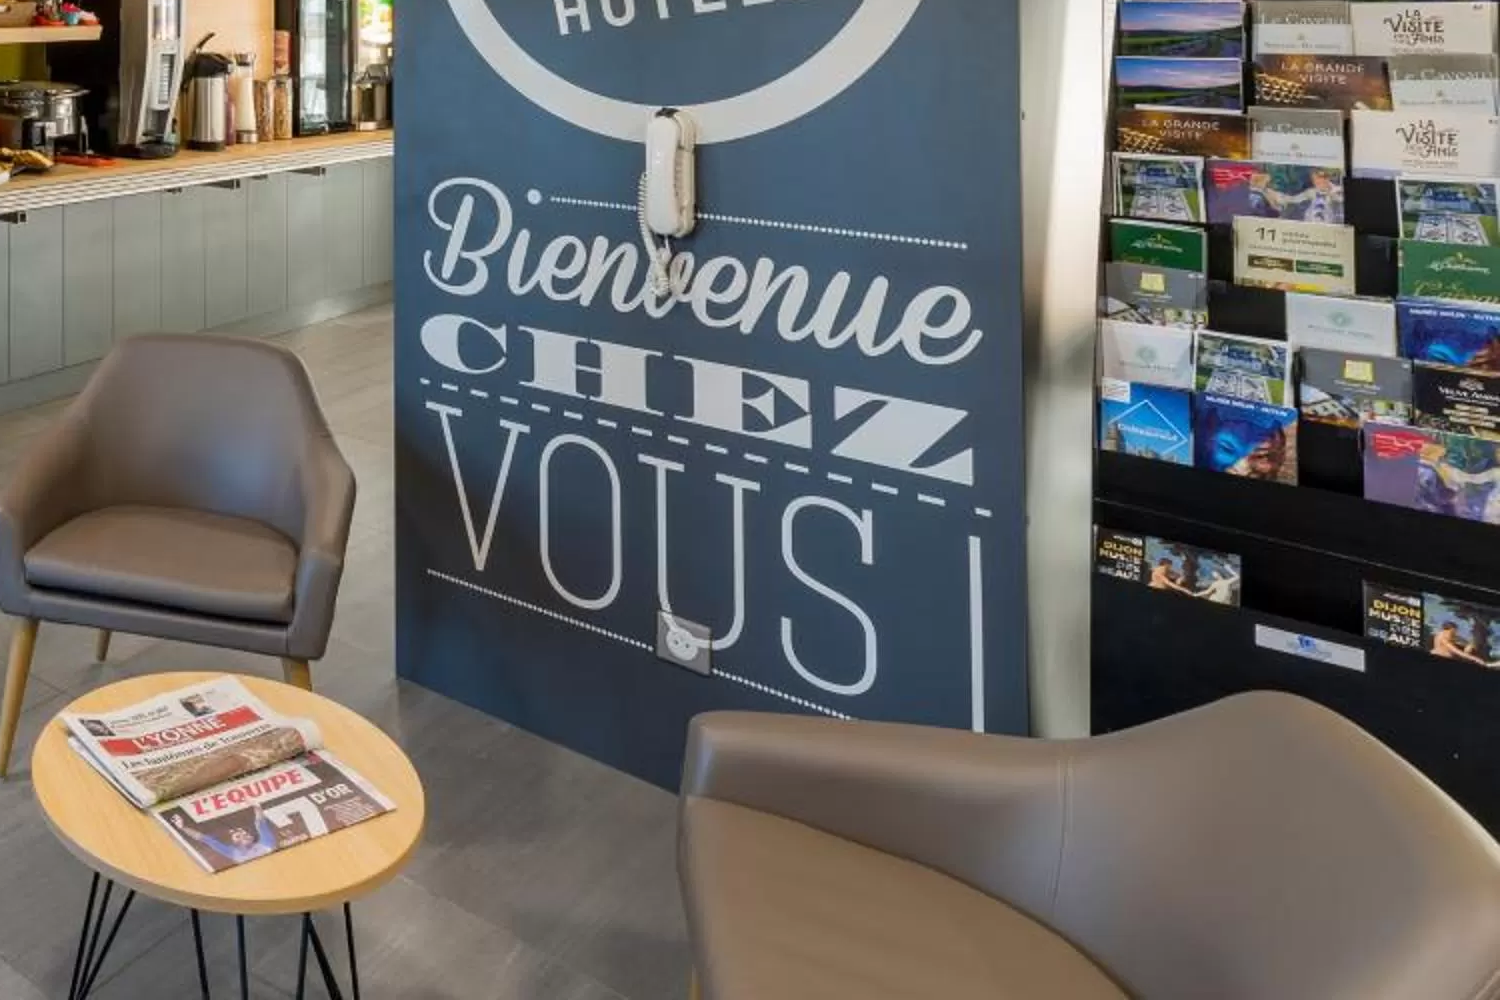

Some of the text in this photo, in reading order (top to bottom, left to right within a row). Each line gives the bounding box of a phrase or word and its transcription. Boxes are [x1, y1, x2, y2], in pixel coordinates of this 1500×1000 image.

[1405, 9, 1421, 18] LA
[1281, 62, 1365, 73] LA GRANDE
[1300, 73, 1347, 85] VISITE
[423, 176, 982, 365] Bienvenue
[419, 313, 975, 487] CHEZ
[425, 401, 878, 695] VOUS
[1103, 541, 1142, 557] DIJON
[1373, 599, 1421, 619] DIJON
[131, 715, 228, 749] L'YONNE
[310, 783, 354, 805] D'OR
